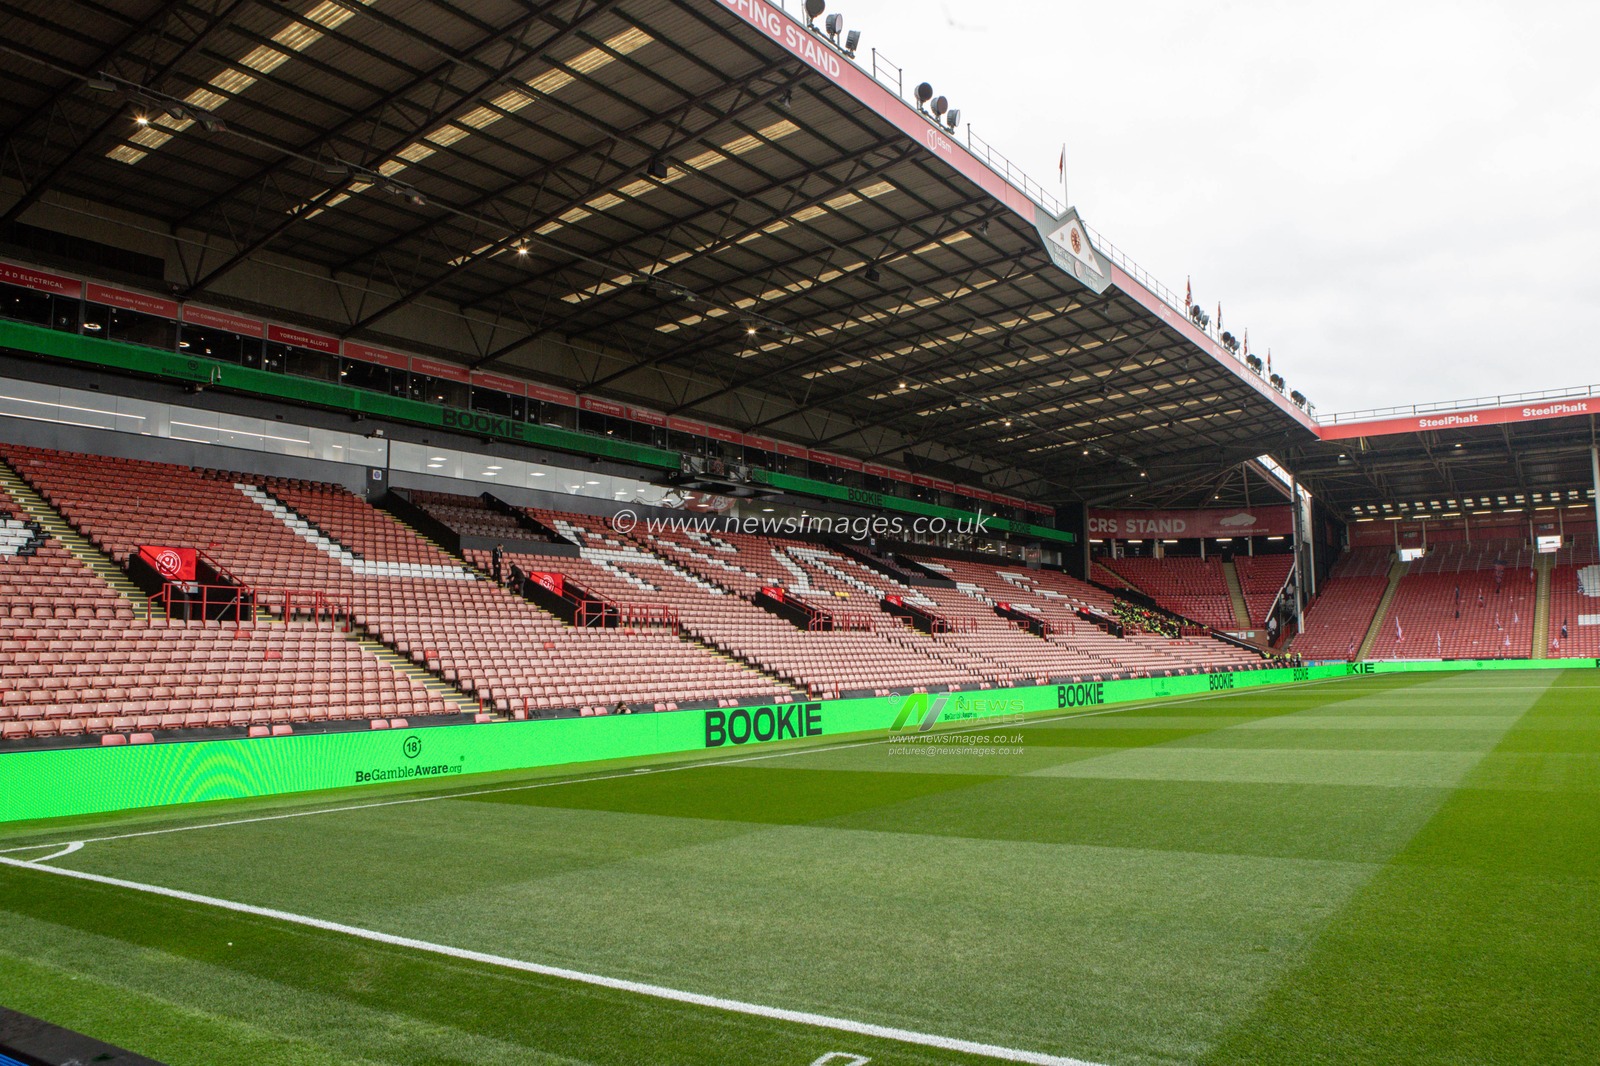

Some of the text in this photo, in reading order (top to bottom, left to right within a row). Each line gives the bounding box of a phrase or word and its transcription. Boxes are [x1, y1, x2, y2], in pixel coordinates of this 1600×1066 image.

[785, 24, 840, 78] STAND
[20, 274, 64, 289] ELECTRICAL
[279, 332, 329, 348] YORKSHIRE ALLOYS
[1523, 402, 1588, 417] SteelPhalt
[442, 408, 524, 439] BOOKIE
[1419, 414, 1479, 428] SteelPhalt
[848, 488, 883, 506] BOOKIE
[1088, 518, 1186, 533] CRS STAND
[1209, 673, 1234, 690] BOOKIE
[1057, 683, 1104, 708] BOOKIE
[705, 703, 823, 748] BOOKIE
[355, 764, 462, 782] BeGambleAware.org
